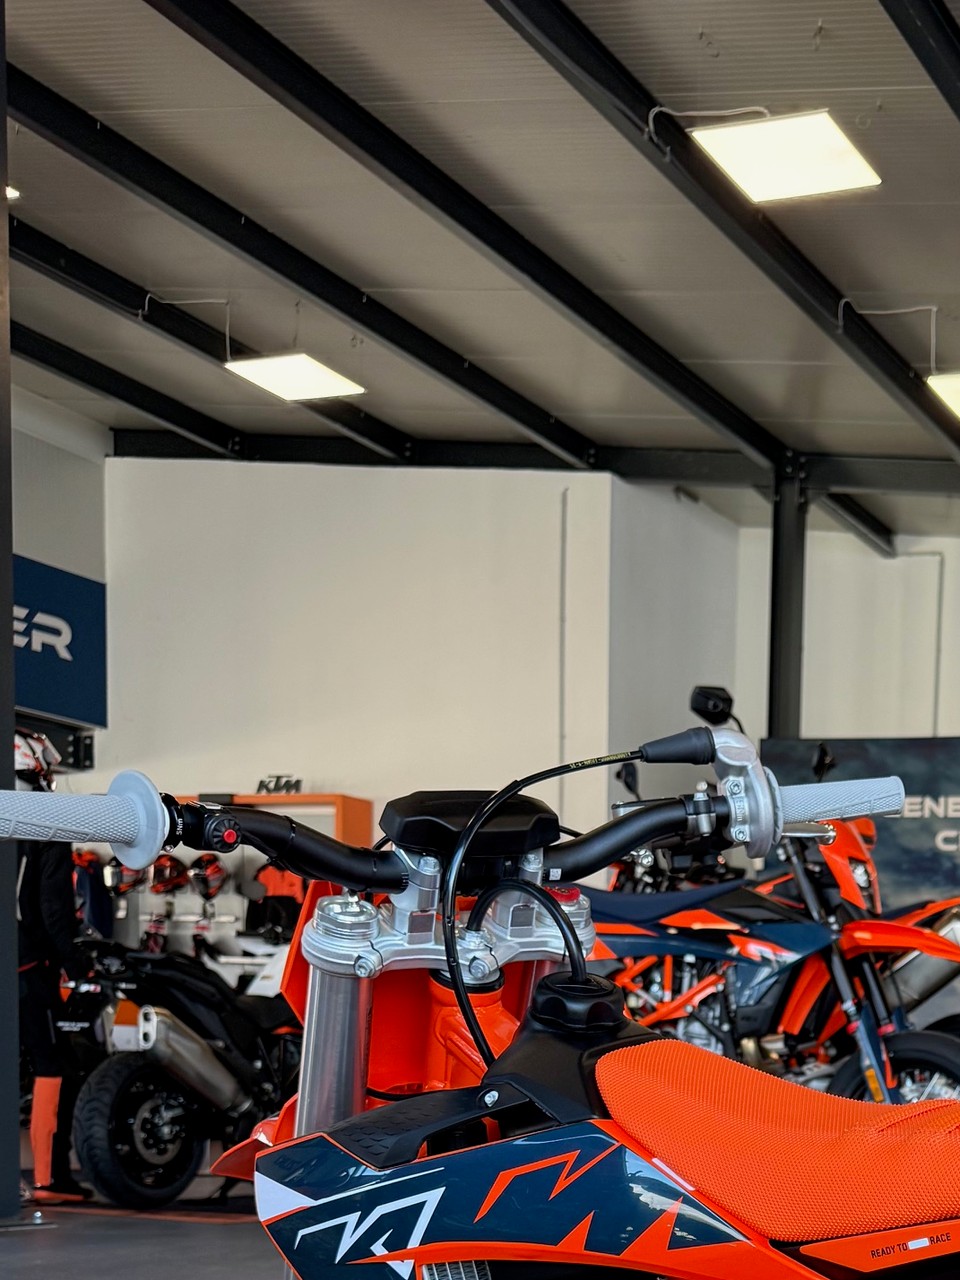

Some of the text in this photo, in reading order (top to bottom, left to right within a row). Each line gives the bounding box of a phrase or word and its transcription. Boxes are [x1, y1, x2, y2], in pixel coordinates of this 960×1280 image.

[256, 774, 303, 794] KTM
[870, 1232, 952, 1259] READY TO RACE
